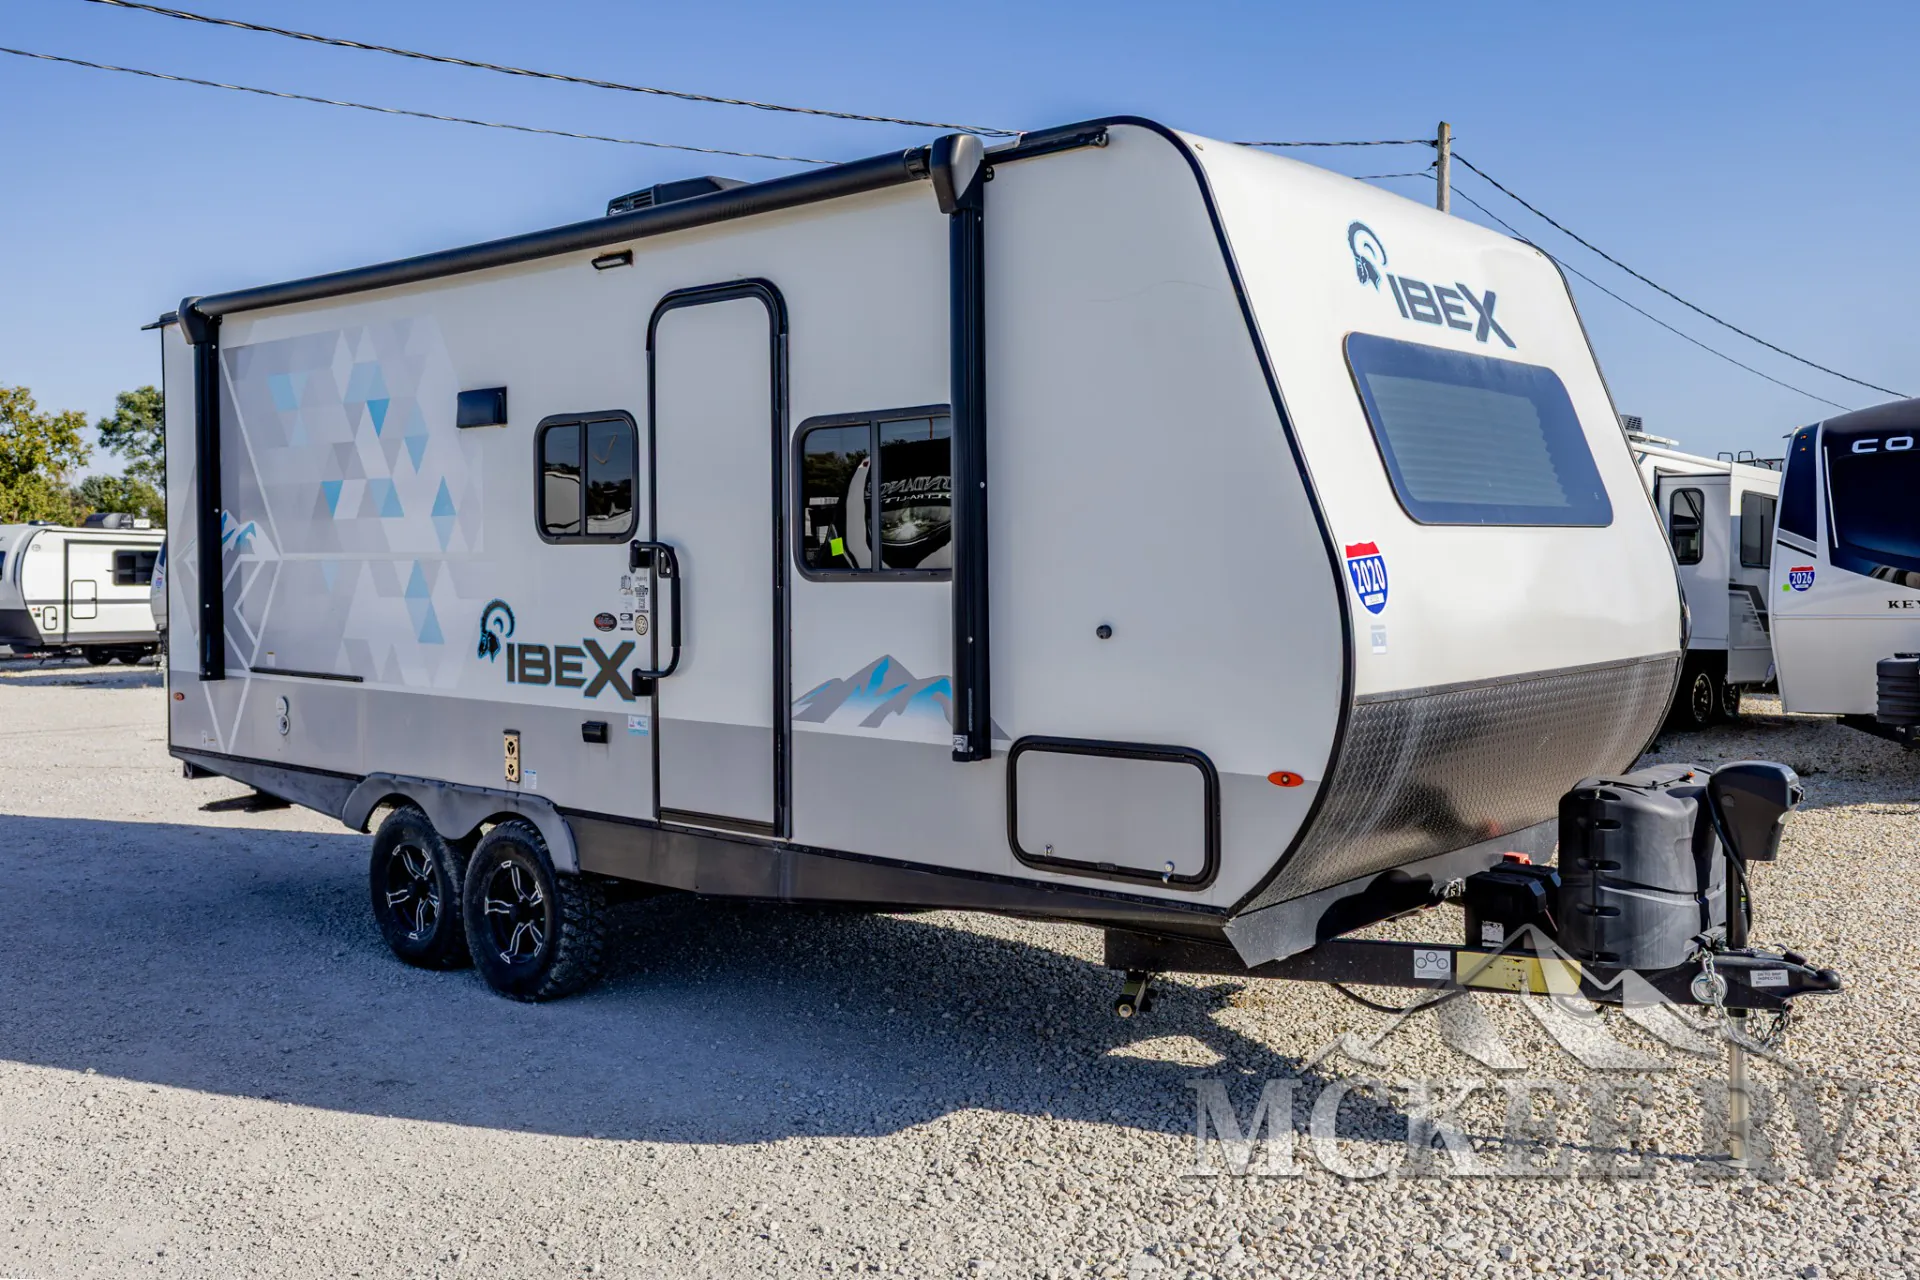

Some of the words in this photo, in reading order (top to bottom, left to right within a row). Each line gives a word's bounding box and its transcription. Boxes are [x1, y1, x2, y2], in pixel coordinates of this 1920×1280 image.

[1386, 272, 1517, 349] IBEX
[1851, 436, 1914, 454] CO
[1352, 558, 1386, 594] 2020
[1791, 572, 1812, 584] 2026
[506, 638, 637, 702] IBEX
